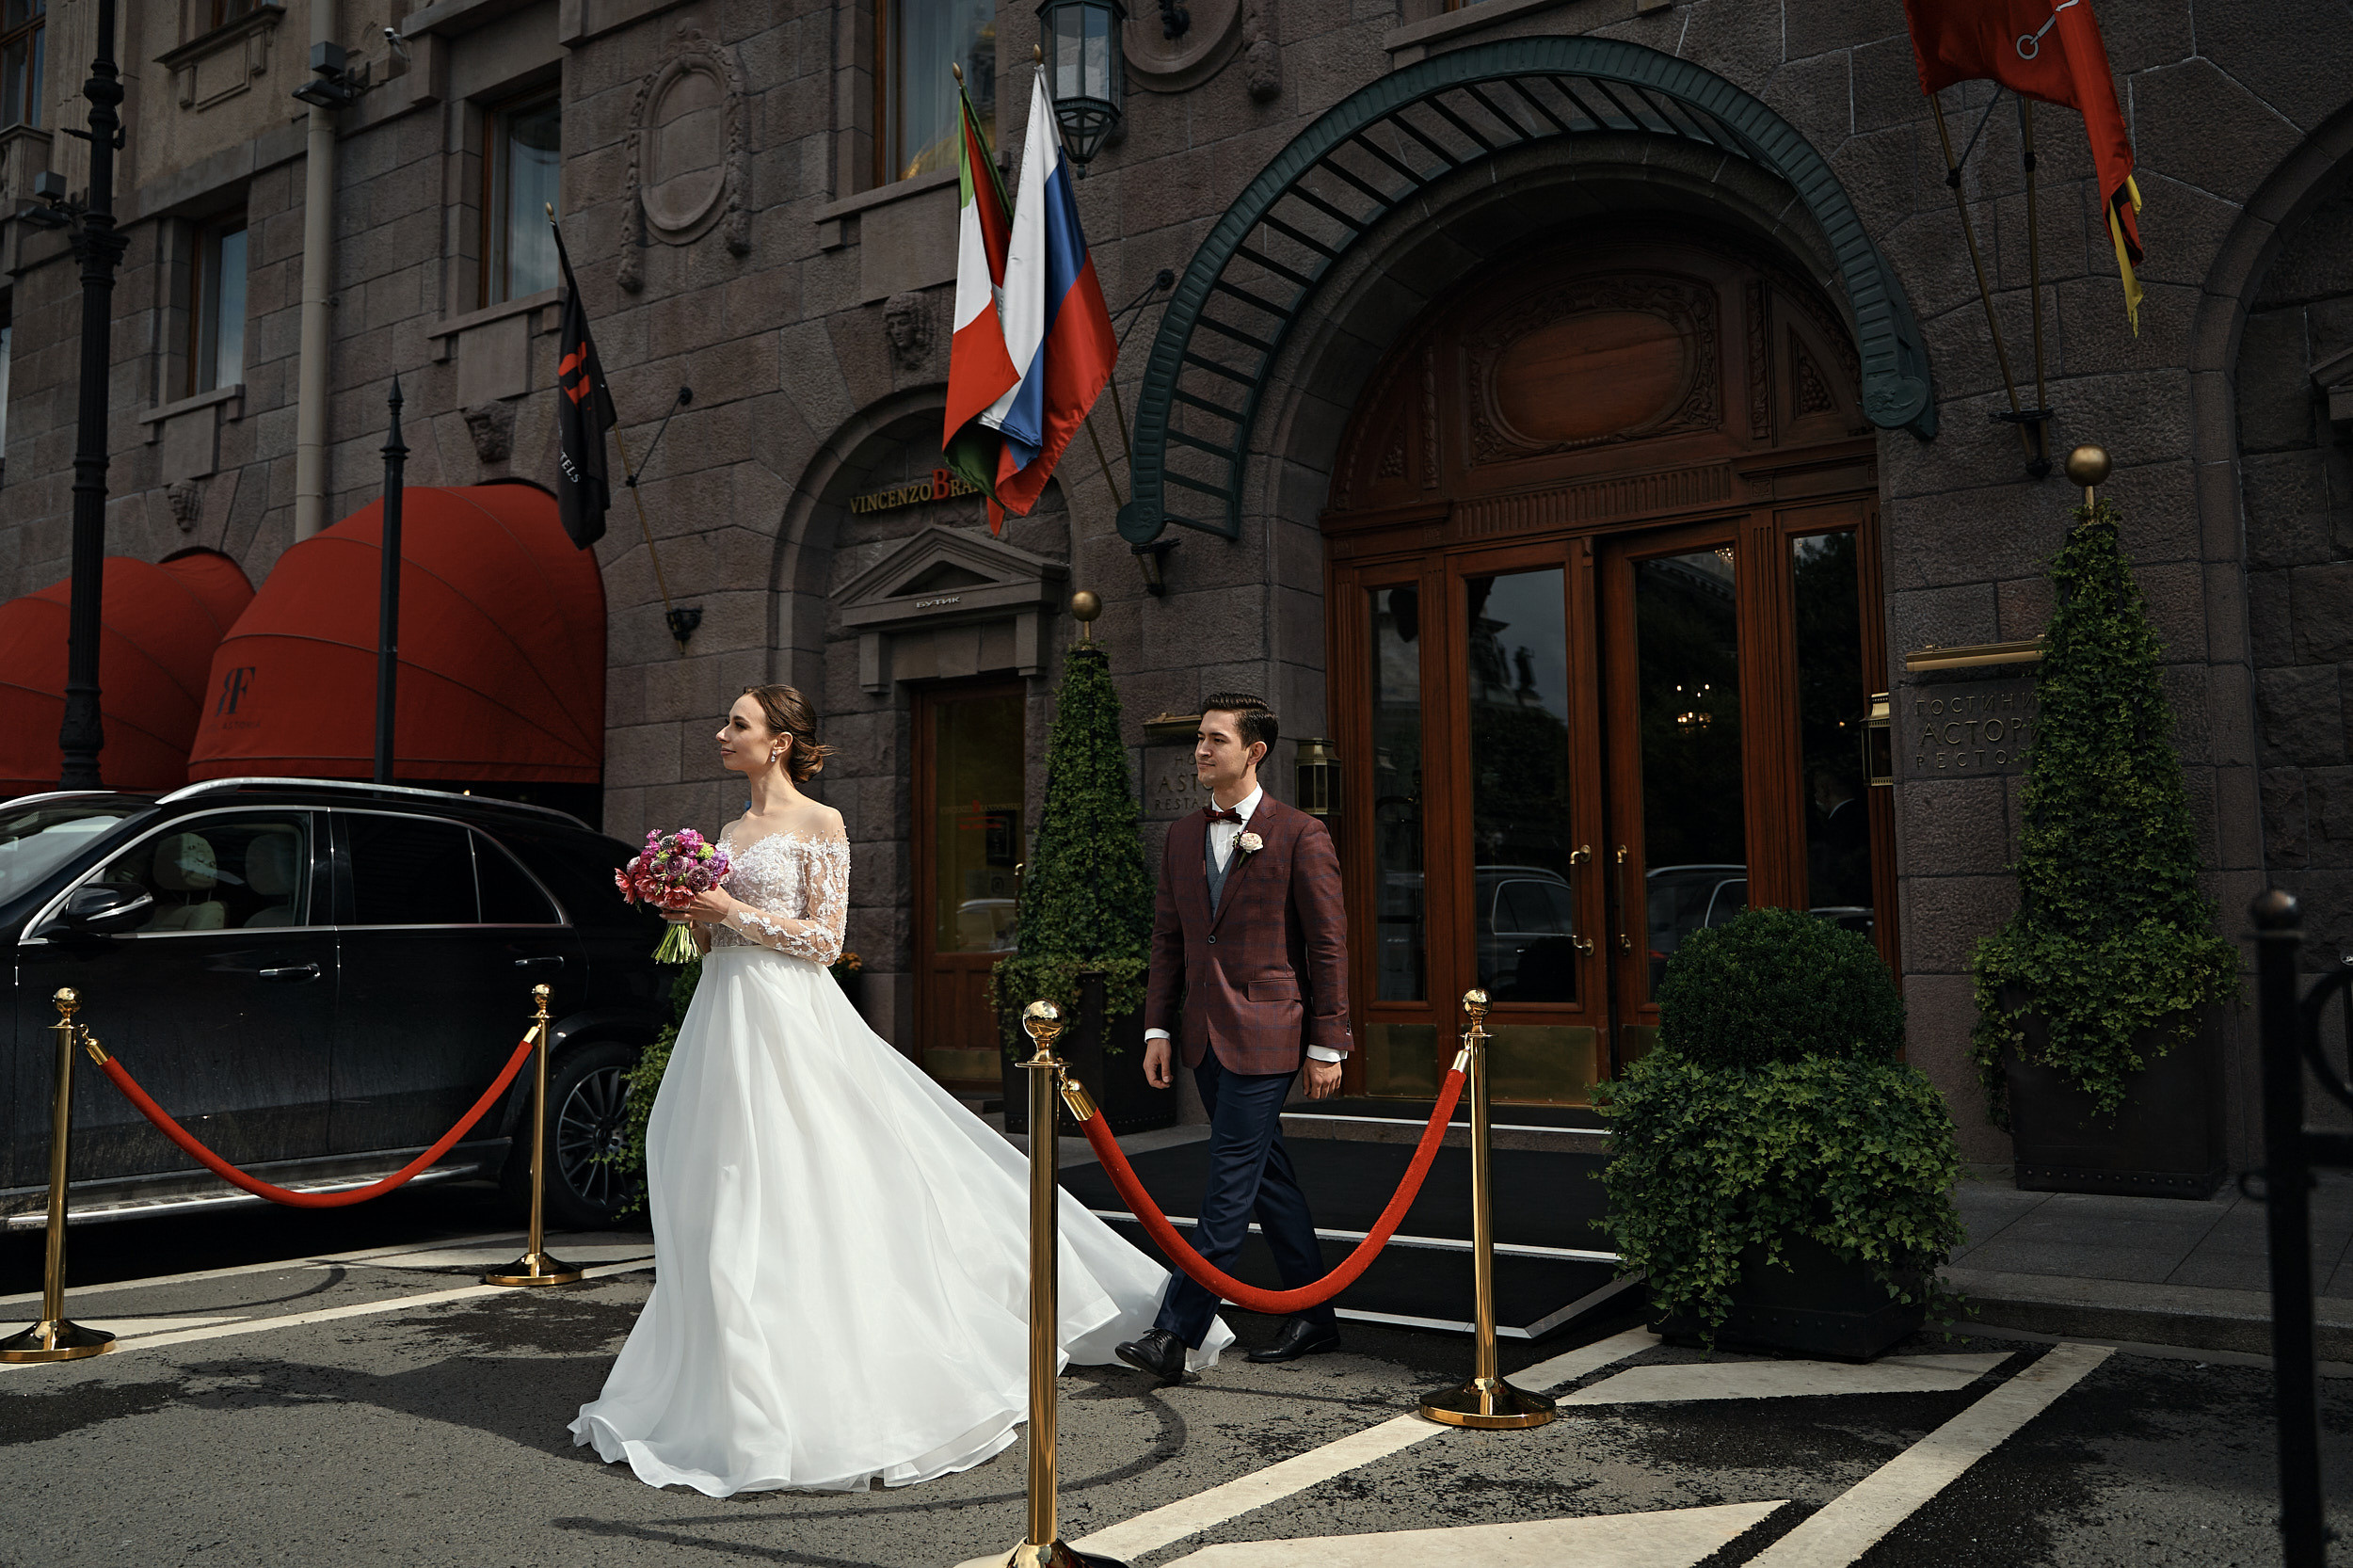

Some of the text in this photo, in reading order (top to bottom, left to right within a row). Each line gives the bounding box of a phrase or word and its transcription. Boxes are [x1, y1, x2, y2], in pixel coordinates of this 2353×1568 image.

[850, 467, 979, 515] VINCENZO BRA
[916, 596, 961, 609] БУТИК
[1915, 748, 2027, 771] РЕСТО
